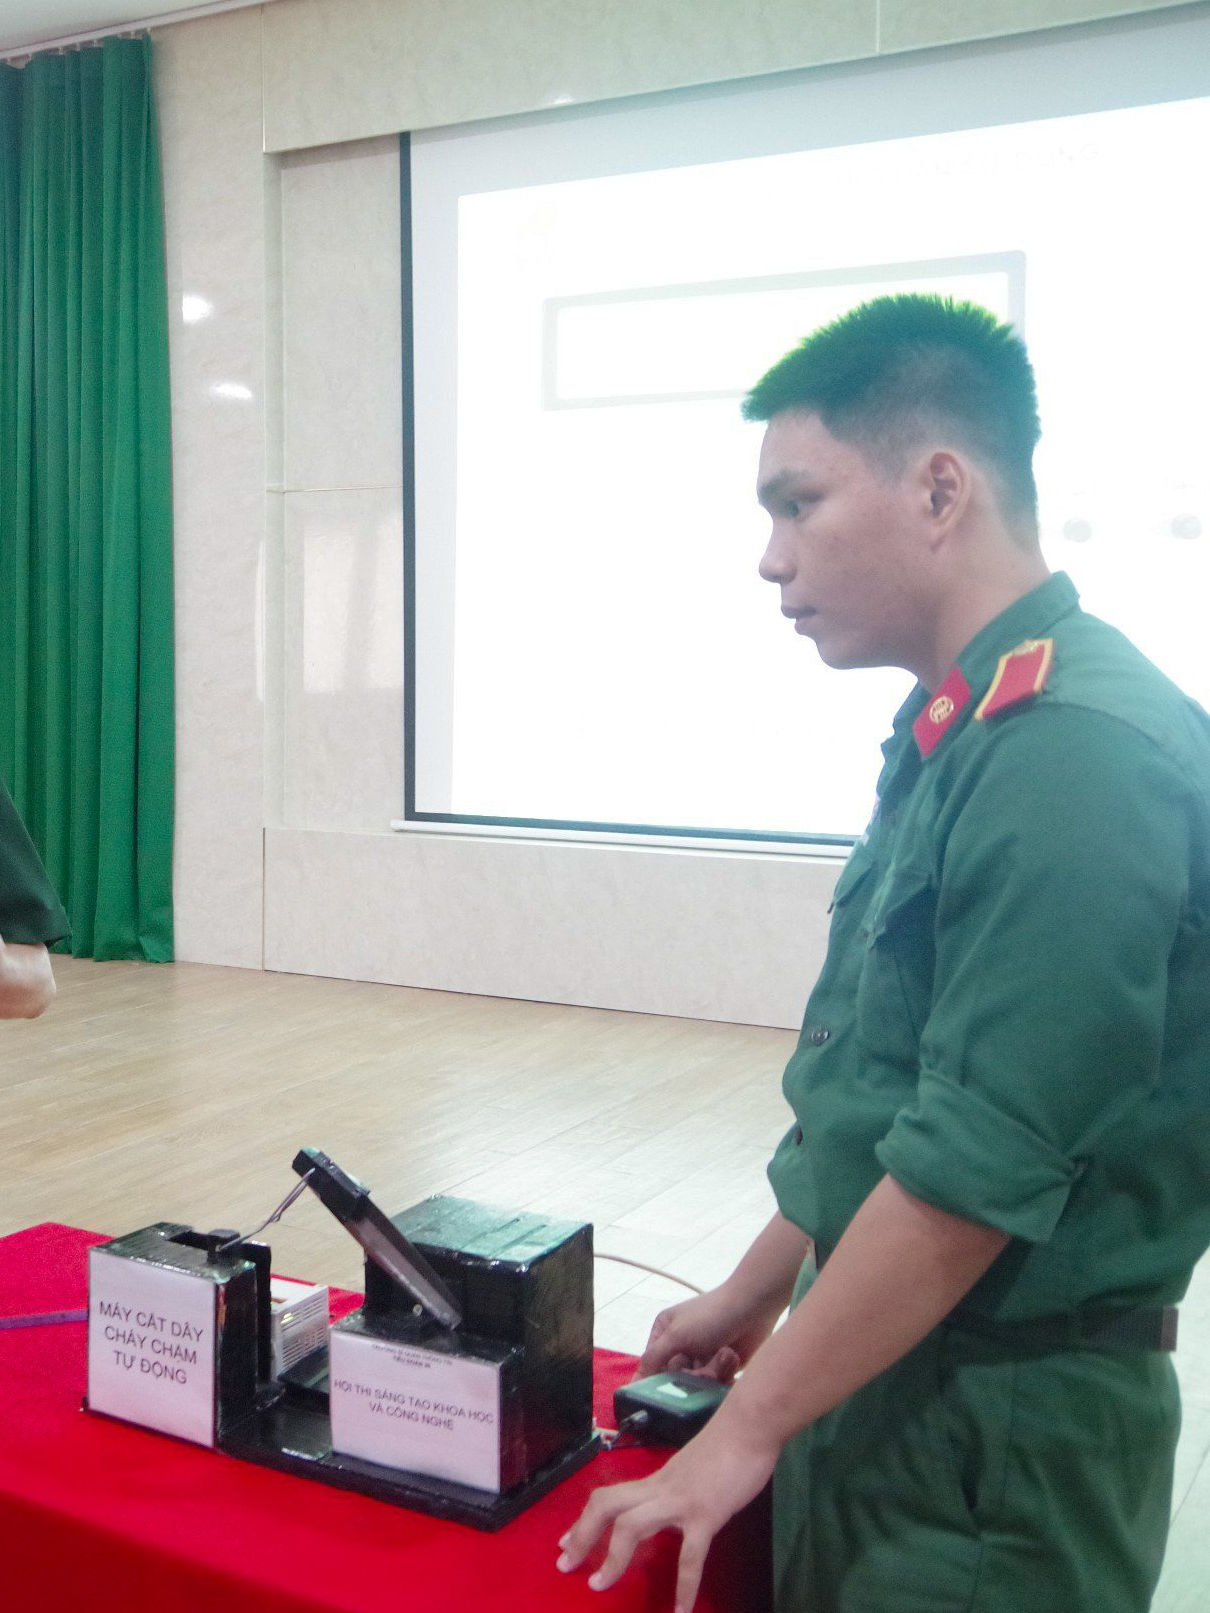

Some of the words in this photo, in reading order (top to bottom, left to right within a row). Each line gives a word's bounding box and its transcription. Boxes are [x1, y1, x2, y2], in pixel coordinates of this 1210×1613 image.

[99, 1301, 133, 1322] MÁY
[104, 1325, 147, 1349] CHÁY
[355, 1384, 372, 1397] THI
[433, 1401, 466, 1417] KHOA
